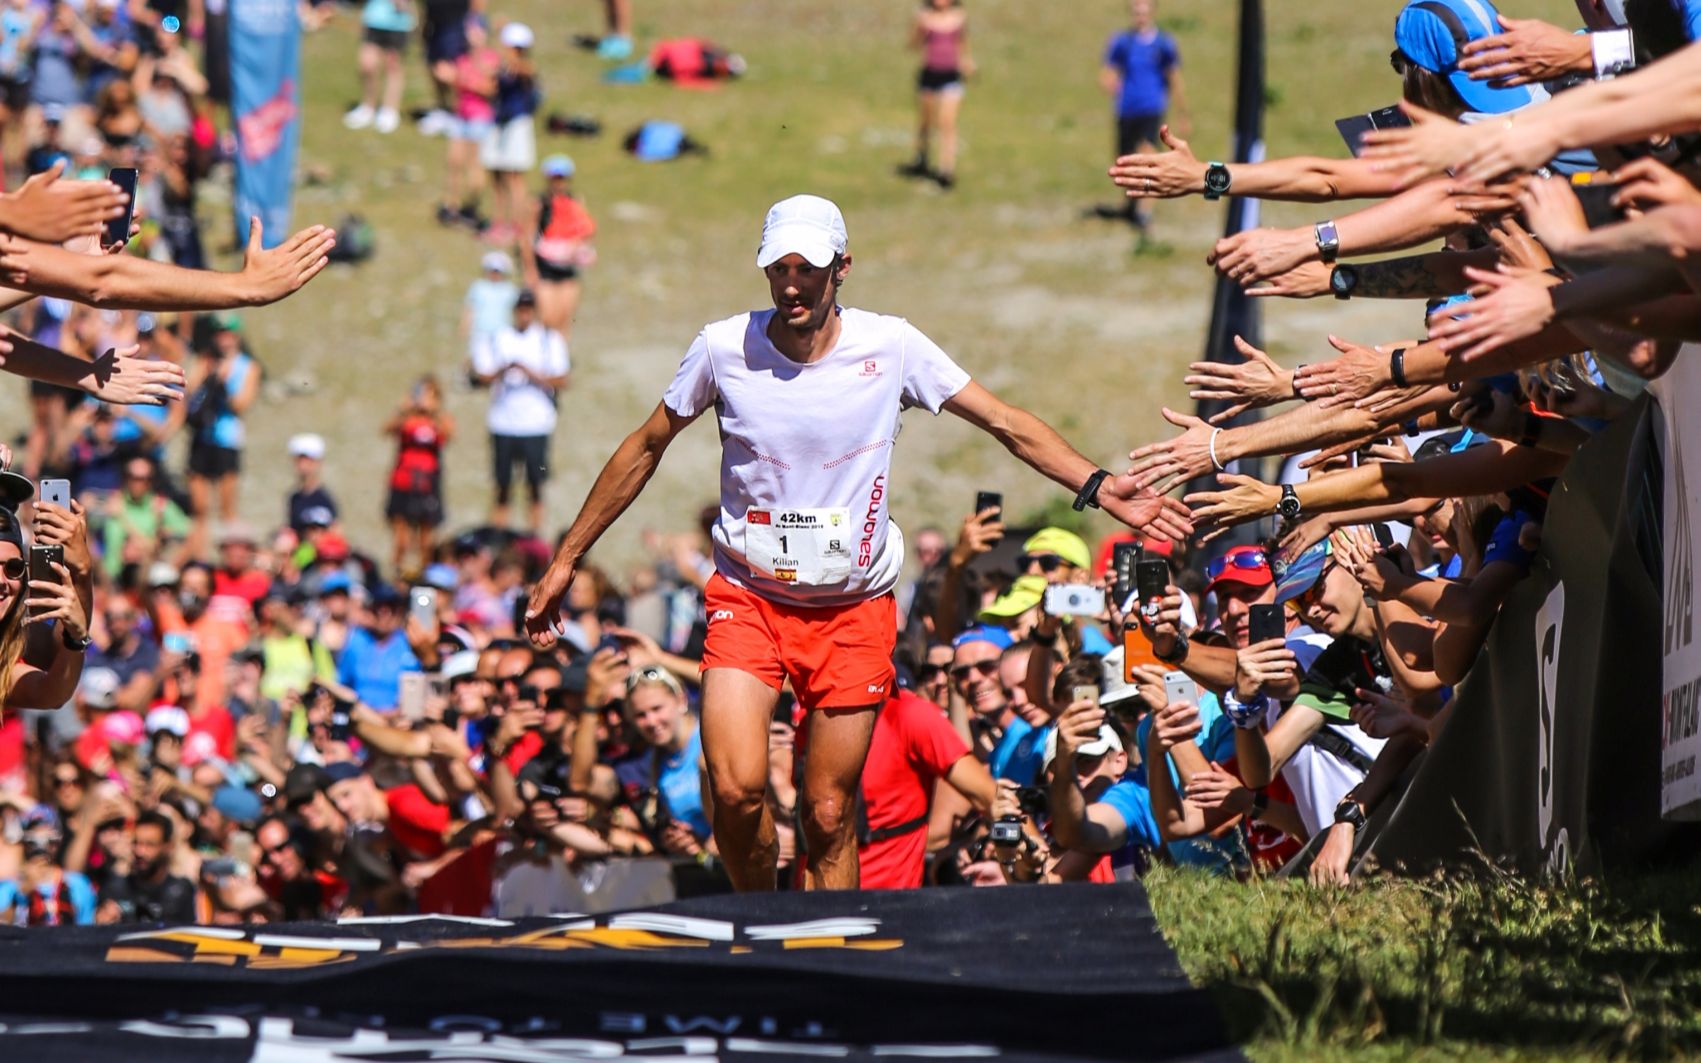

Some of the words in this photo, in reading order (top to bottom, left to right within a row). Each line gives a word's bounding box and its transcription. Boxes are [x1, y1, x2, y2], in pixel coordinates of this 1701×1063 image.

[780, 513, 817, 523] 42km
[779, 535, 788, 554] 1
[772, 557, 799, 567] Kilian
